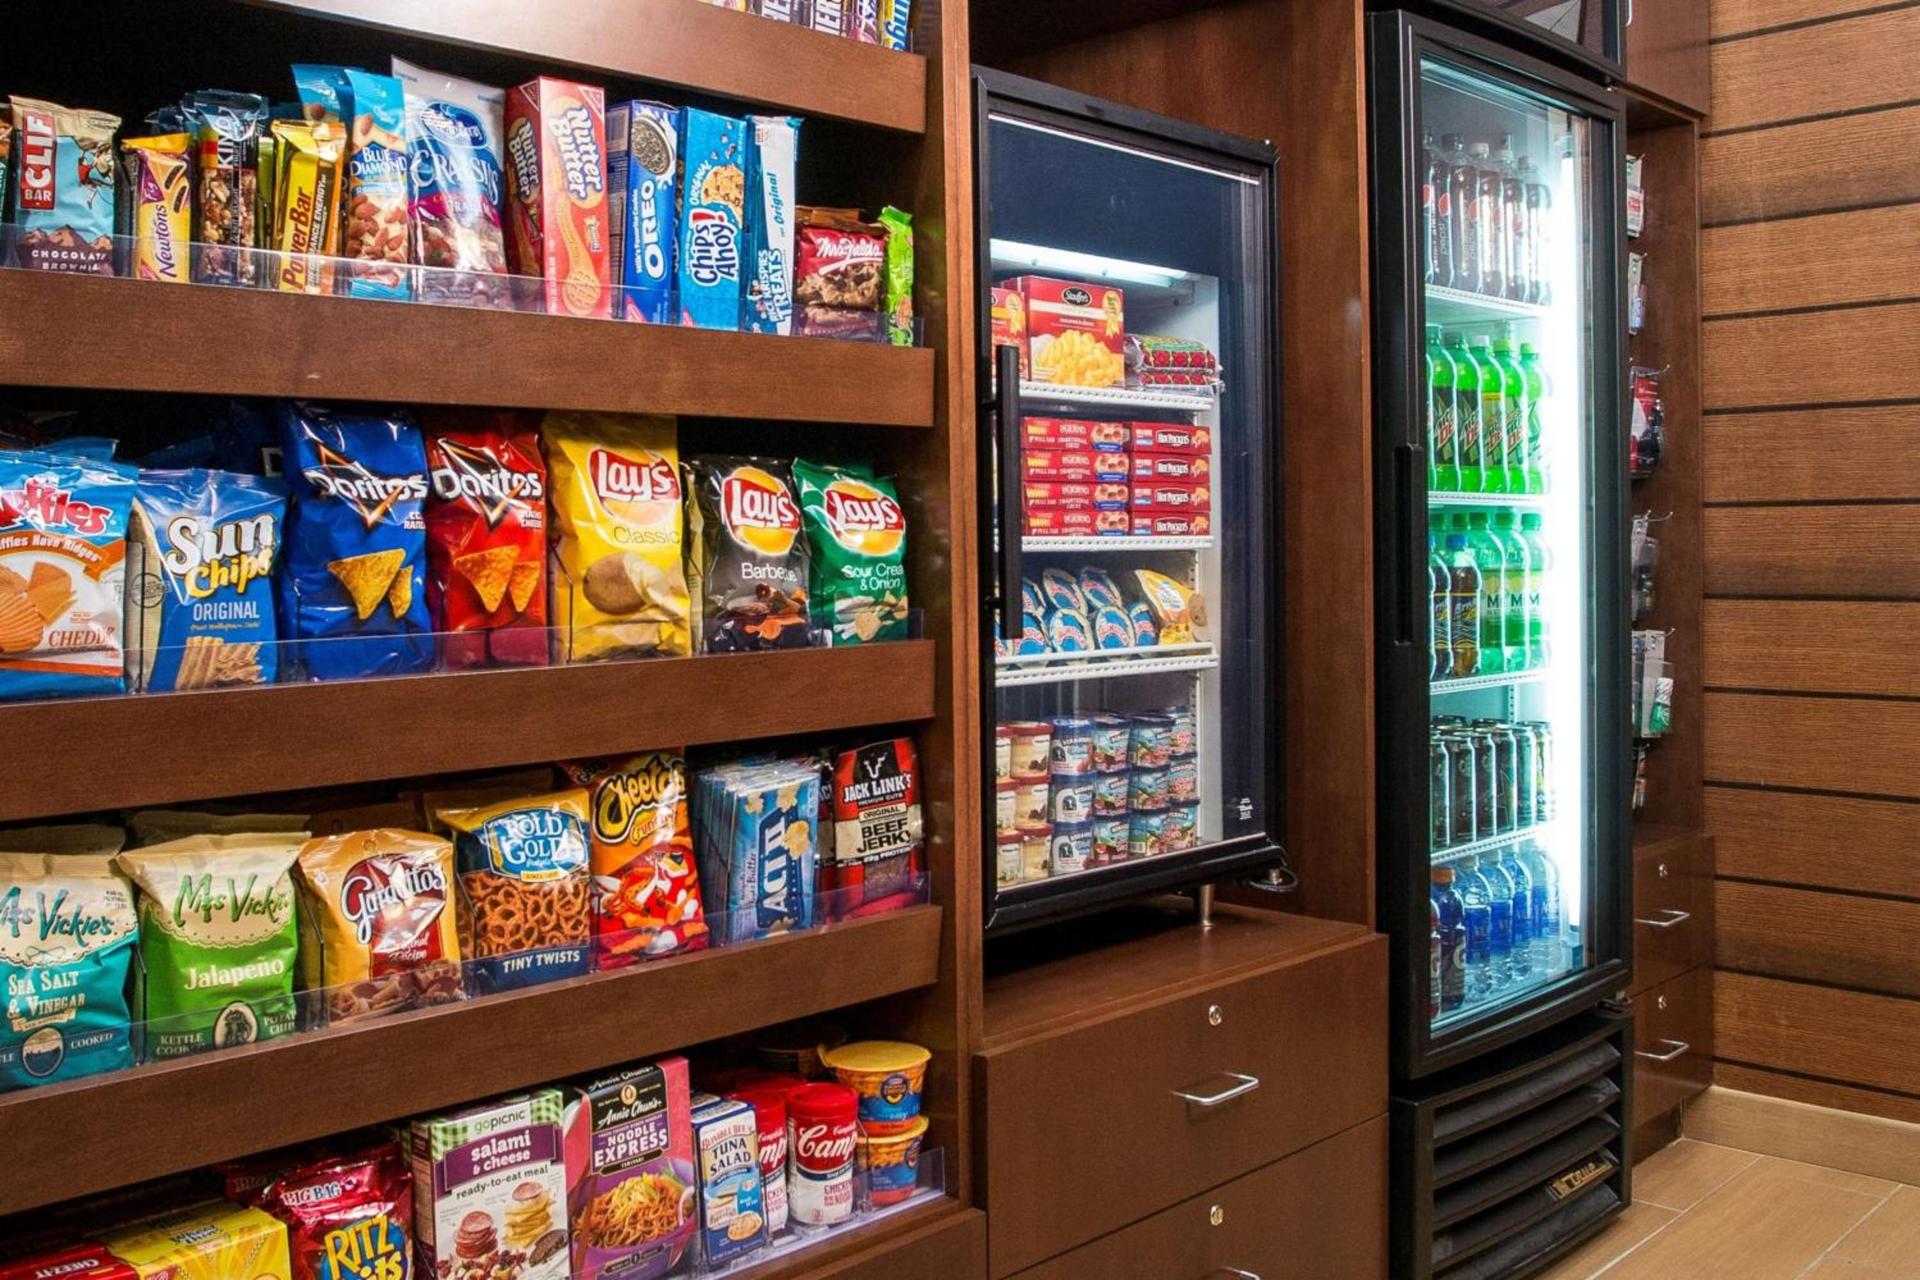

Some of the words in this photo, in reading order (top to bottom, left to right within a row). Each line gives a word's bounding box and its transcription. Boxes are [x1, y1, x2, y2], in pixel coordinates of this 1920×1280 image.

[26, 115, 54, 188] CLIF
[362, 146, 390, 163] BLUE
[519, 122, 540, 186] Nutter
[550, 116, 588, 200] Butter
[565, 105, 603, 195] Nutter
[508, 137, 532, 198] Butter
[689, 160, 712, 206] ORIGINAL
[24, 188, 53, 201] BAR
[766, 172, 785, 225] Original
[155, 203, 178, 278] Newtons
[282, 186, 312, 289] PowerBar
[641, 180, 665, 279] OREO
[692, 224, 718, 285] Chips
[758, 249, 774, 299] KRISPIES
[768, 247, 792, 322] TREATS
[302, 469, 428, 501] Doritos
[431, 469, 543, 500] Doritos
[598, 451, 679, 501] Lay's
[732, 479, 797, 528] Lay's
[833, 488, 900, 526] Lay's
[32, 534, 62, 548] Have
[166, 513, 277, 576] Sun
[613, 525, 681, 545] Classic
[185, 548, 274, 599] Chips
[844, 563, 873, 579] Sour
[875, 562, 904, 576] Crea
[860, 579, 869, 590] &
[869, 577, 902, 590] Onion
[192, 600, 261, 621] ORIGINAL
[843, 781, 870, 802] JACK
[871, 773, 912, 796] LINK'S
[861, 817, 908, 839] BEEF
[863, 805, 900, 819] ORIGINAL
[857, 830, 912, 853] JERKY
[184, 956, 285, 990] Jalapeño
[502, 958, 532, 973] TINY
[536, 950, 581, 967] TWISTS
[40, 970, 79, 992] SALT
[25, 992, 86, 1016] VINEGAR
[70, 1032, 114, 1050] COOKED
[473, 1109, 526, 1135] gopicnic
[597, 1106, 631, 1129] Annie
[470, 1129, 532, 1162] salami
[594, 1128, 668, 1168] EXPRESS
[607, 1121, 657, 1147] NOODLE
[712, 1137, 748, 1160] TUNA
[472, 1163, 482, 1176] &
[483, 1149, 532, 1172] cheese
[709, 1151, 753, 1176] SALAD
[282, 1189, 312, 1206] BIG
[313, 1182, 342, 1200] BAG
[456, 1171, 524, 1201] ready-to-eat
[525, 1164, 550, 1182] meal
[324, 1215, 395, 1280] RITZ
